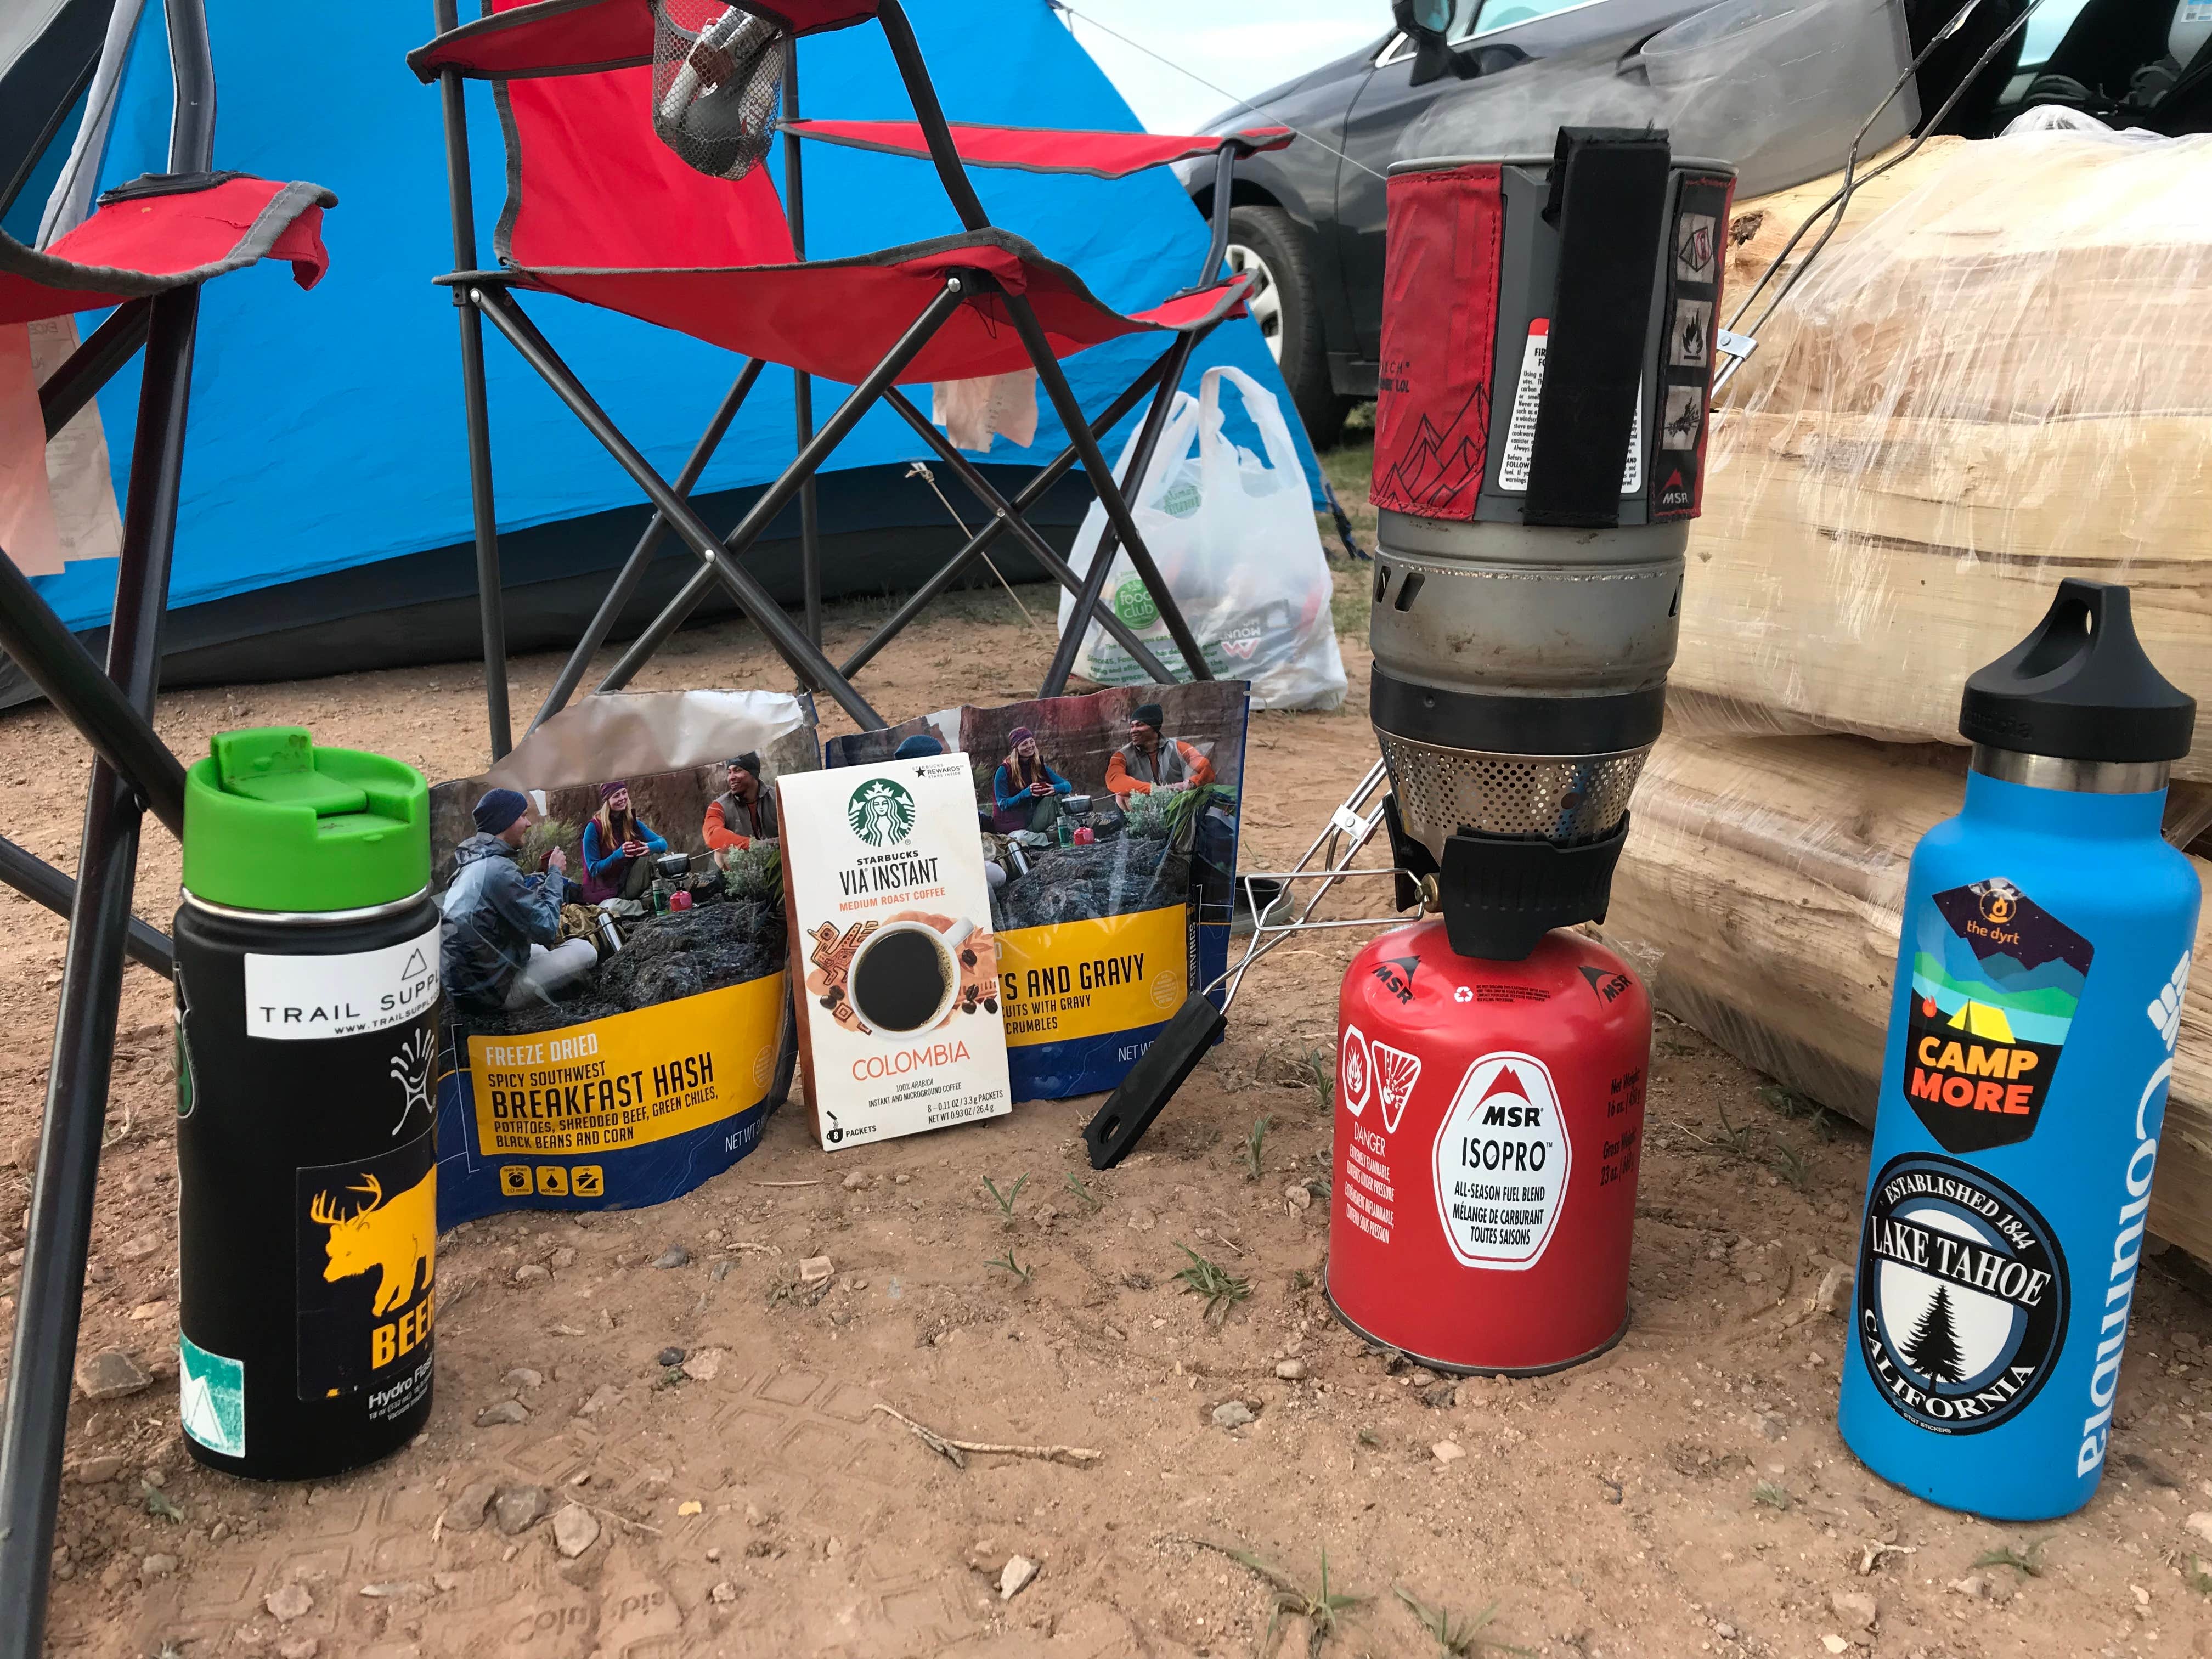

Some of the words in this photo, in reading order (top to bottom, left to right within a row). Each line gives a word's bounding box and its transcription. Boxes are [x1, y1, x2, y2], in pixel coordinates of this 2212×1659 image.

[1534, 348, 1547, 357] FIR
[1523, 370, 1537, 379] Using
[1662, 492, 1688, 505] MSR
[1124, 601, 1154, 618] club
[1223, 627, 1261, 640] MOUN
[912, 763, 944, 771] STRBUCKS
[857, 850, 919, 866] STARBUCKS
[872, 857, 939, 891] INSTANT
[839, 896, 878, 912] MEDIUM
[881, 893, 910, 906] ROAST
[913, 887, 946, 901] COFFEE
[1966, 920, 1989, 937] the
[1990, 927, 2020, 946] dyrt
[1027, 965, 1070, 998] AND
[1079, 952, 1144, 990] GRAVY
[1371, 964, 1414, 1006] MSR
[1601, 973, 1632, 1003] MSR
[259, 1003, 360, 1023] TRAIL
[380, 969, 439, 1011] SUPPL
[1031, 1000, 1057, 1014] WITH
[1060, 994, 1091, 1011] GRAVY
[1006, 1017, 1058, 1035] CRUMBLES
[486, 1043, 544, 1066] FREEZE
[551, 1033, 598, 1062] DRIED
[852, 1040, 970, 1081] COLOMBIA
[1118, 1044, 1139, 1062] NET
[1918, 1036, 2039, 1080] CAMP
[488, 1073, 525, 1089] SPICY
[531, 1060, 606, 1087] SOUTHWEST
[493, 1070, 644, 1119] BREAKFAST
[654, 1051, 714, 1098] HASH
[895, 1082, 911, 1092] 100%
[911, 1077, 934, 1089] ARABICA
[868, 1097, 891, 1108] INSTANT
[891, 1094, 904, 1103] AND
[904, 1086, 942, 1101] MICROGROUND
[943, 1082, 962, 1093] COFFEE
[927, 1104, 932, 1113] 8
[938, 1101, 951, 1111] 0.11
[951, 1099, 959, 1109] OZ
[963, 1096, 973, 1107] 3.3
[978, 1090, 1003, 1103] PACKETS
[1911, 1066, 2034, 1115] MORE
[494, 1120, 555, 1134] POTATOES,
[559, 1111, 618, 1131] SHREDDED
[623, 1107, 649, 1125] BEEF,
[652, 1099, 682, 1119] GREEN
[685, 1086, 718, 1109] CHILES,
[928, 1115, 939, 1124] NET
[940, 1113, 950, 1122] WT
[951, 1109, 964, 1120] 0.93
[964, 1108, 972, 1116] OZ
[977, 1104, 989, 1114] 26.4
[1482, 1105, 1542, 1127] MSR
[496, 1135, 532, 1149] BLACK
[535, 1134, 574, 1149] BEANS
[577, 1131, 600, 1147] AND
[604, 1127, 634, 1144] CORN
[725, 1130, 743, 1153] NET
[744, 1122, 756, 1143] WT
[833, 1131, 839, 1140] 8
[845, 1125, 877, 1138] PACKETS
[1353, 1121, 1386, 1158] DANGER
[1361, 1170, 1373, 1192] UNDER
[1373, 1179, 1395, 1203] PRESSURE
[1454, 1180, 1500, 1201] ALL-SEASON
[1503, 1186, 1520, 1202] FUEL
[1522, 1186, 1545, 1201] BLEND
[1452, 1200, 1487, 1223] MÉLANGE
[1488, 1209, 1498, 1224] DE
[1501, 1208, 1544, 1226] CARBURANT
[1884, 1173, 2000, 1216] ESTABLISHED
[1995, 1213, 2037, 1250] 1844
[1359, 1215, 1370, 1234] SOUS
[1369, 1221, 1390, 1244] PRESSION
[1470, 1225, 1498, 1245] TOUTES
[1499, 1227, 1531, 1245] SAISONS
[1871, 1215, 1929, 1269] LAKE
[1936, 1236, 2052, 1307] TAHOE
[1864, 1308, 2036, 1420] CALIFORNIA
[369, 1377, 413, 1410] Hydro
[1920, 1422, 1952, 1434] STICKERS
